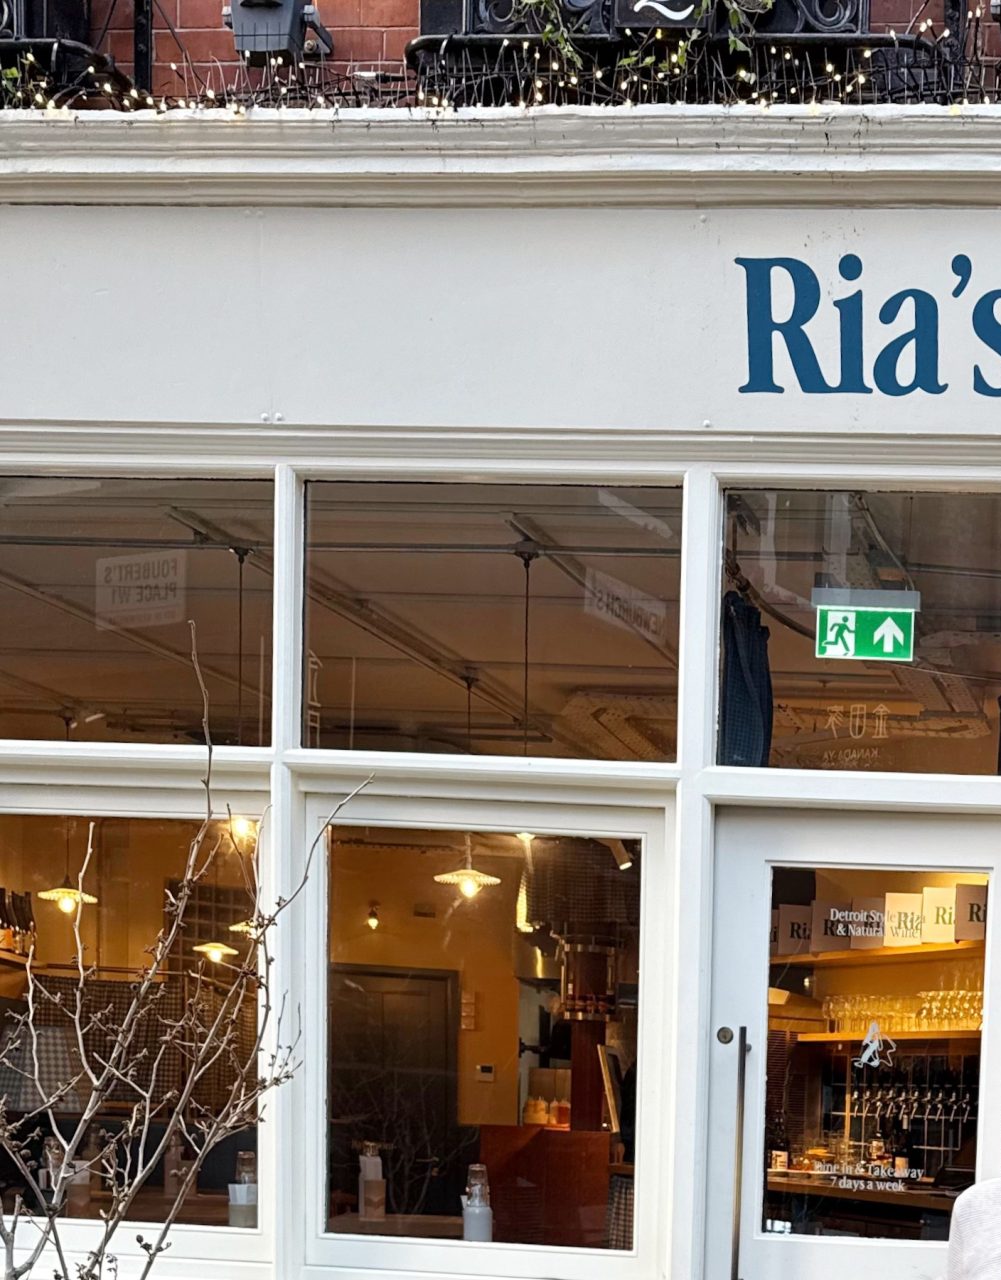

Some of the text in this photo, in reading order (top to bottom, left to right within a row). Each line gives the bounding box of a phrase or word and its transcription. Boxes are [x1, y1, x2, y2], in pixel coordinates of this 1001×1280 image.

[830, 908, 869, 922] Detroit
[869, 909, 897, 928] Style
[836, 923, 847, 936] &
[855, 1162, 866, 1175] &
[866, 1163, 924, 1182] Takeaway
[830, 1175, 906, 1192] 7 days a week
